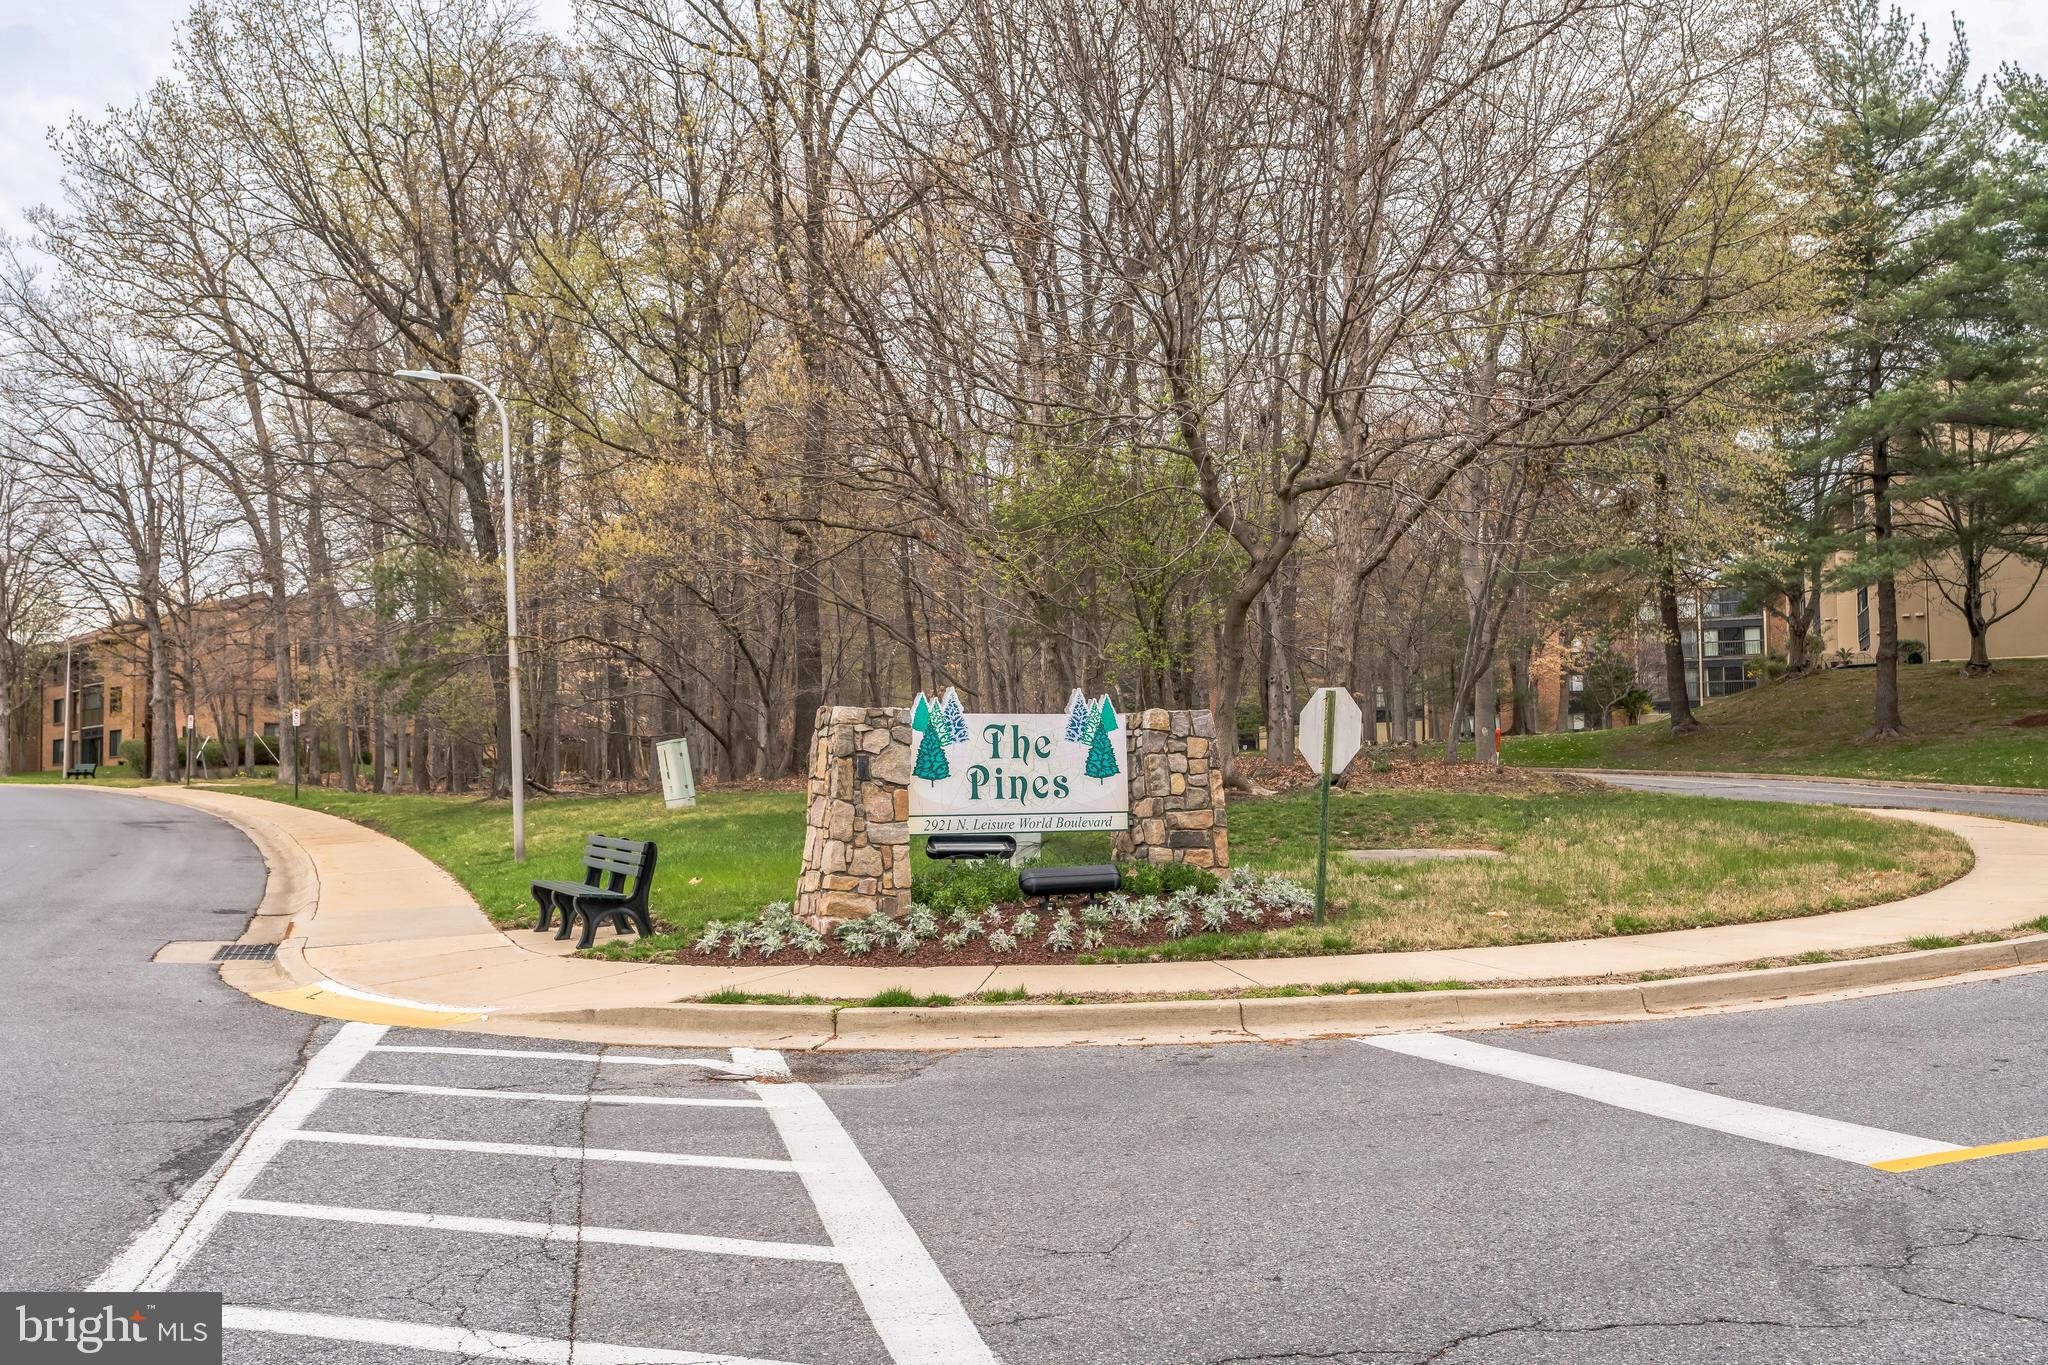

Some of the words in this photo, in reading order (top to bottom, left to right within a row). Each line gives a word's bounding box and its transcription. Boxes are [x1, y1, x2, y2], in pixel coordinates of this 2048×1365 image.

[983, 723, 1051, 766] The
[966, 764, 1070, 806] Pines
[923, 819, 952, 832] 2921
[956, 819, 969, 831] N.
[973, 818, 1015, 831] Leisure
[1019, 817, 1053, 830] World
[1056, 816, 1113, 829] Boulevard
